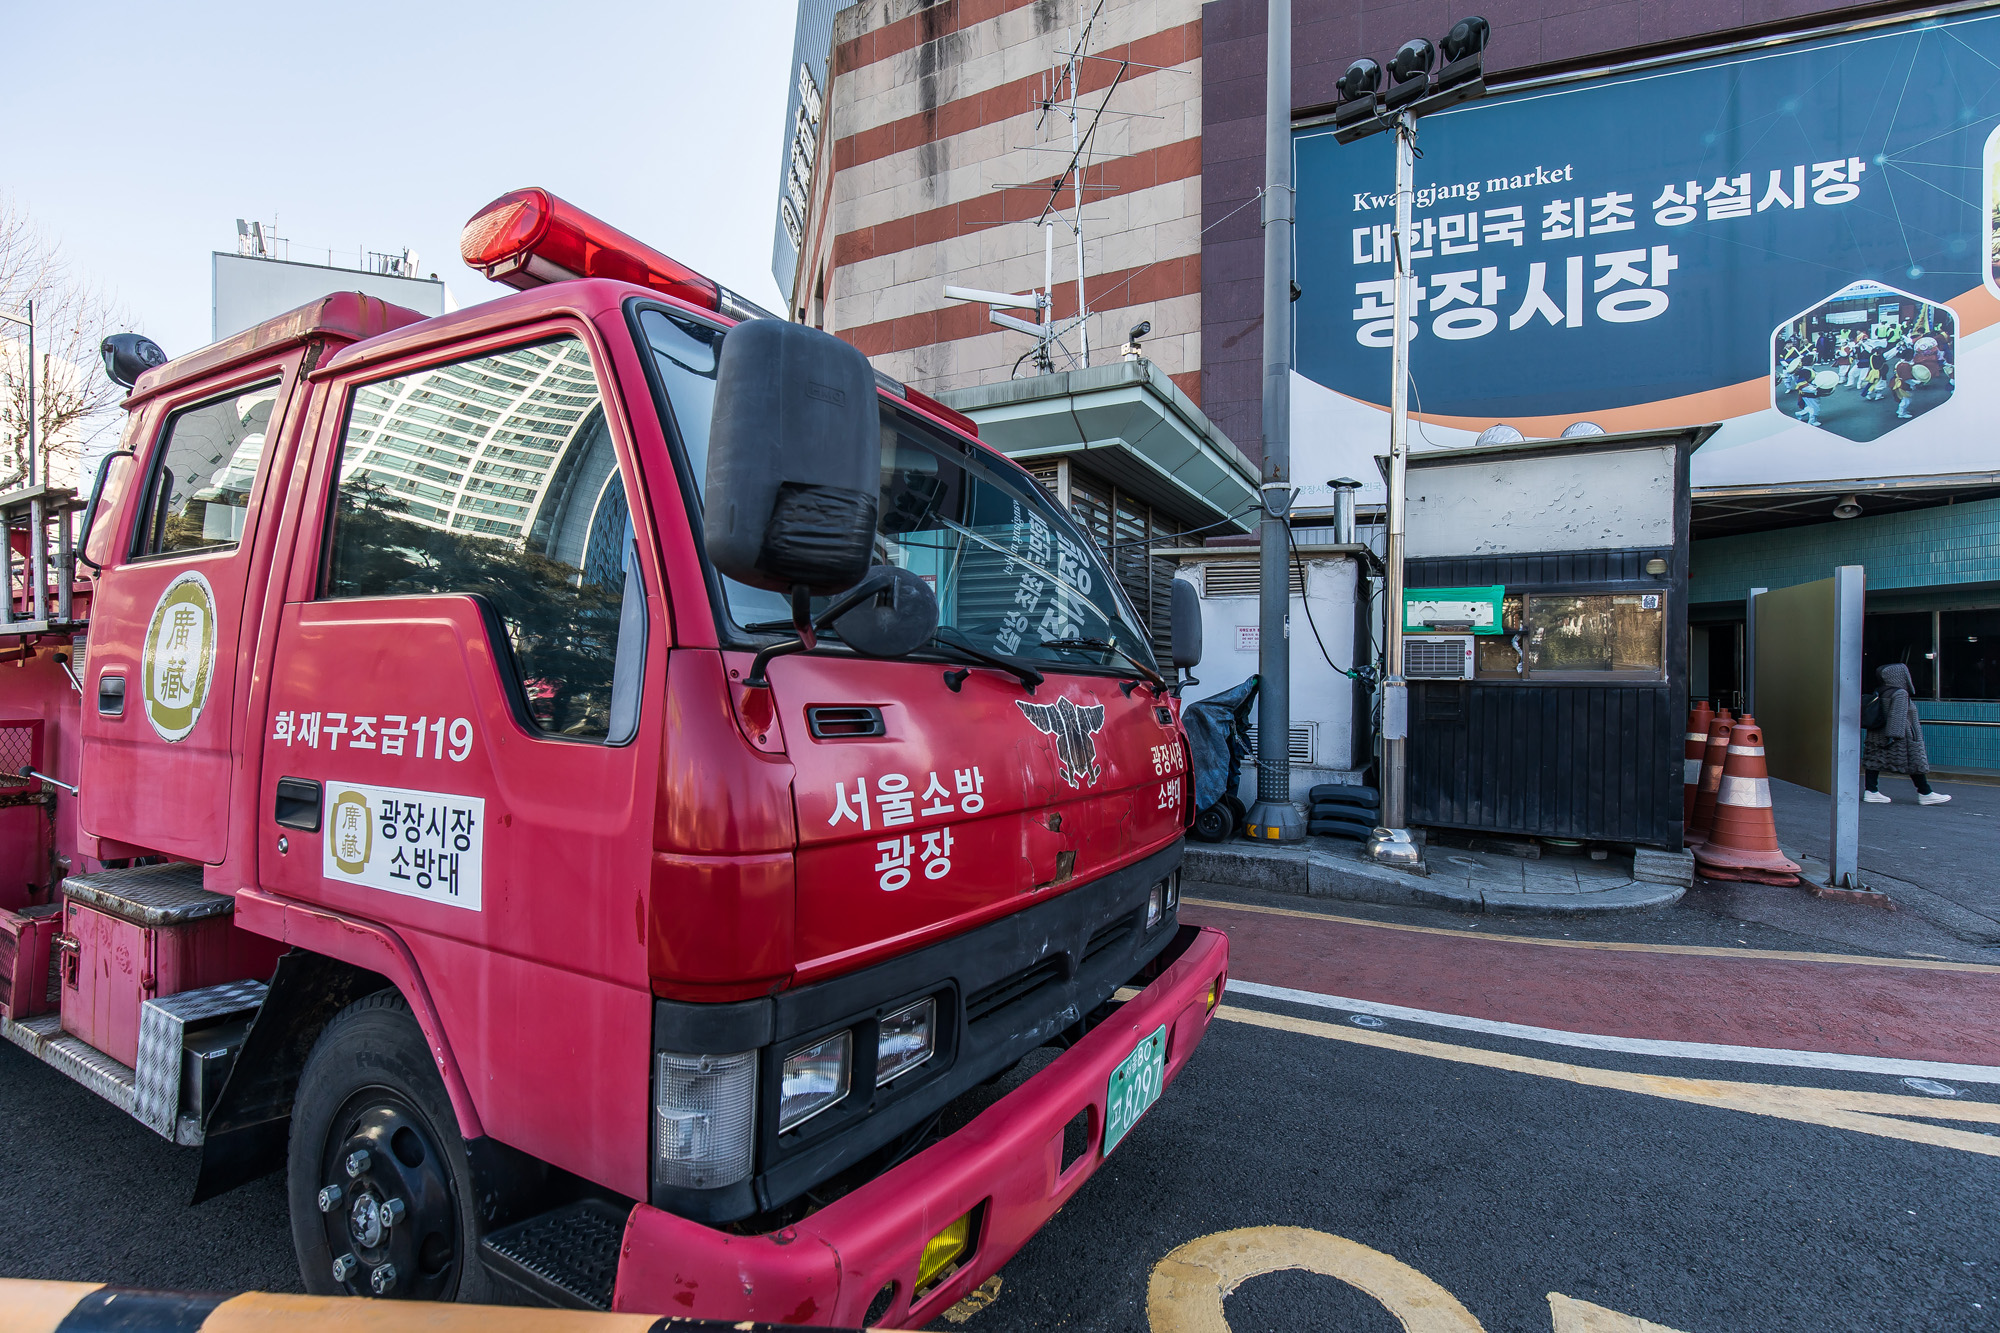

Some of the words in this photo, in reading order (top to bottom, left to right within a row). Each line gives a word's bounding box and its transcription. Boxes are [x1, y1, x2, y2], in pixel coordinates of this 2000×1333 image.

[1352, 181, 1481, 212] Kwagjang
[1487, 163, 1574, 193] market
[1541, 192, 1637, 241] 최초
[1652, 156, 1867, 228] 상설시장
[1352, 245, 1679, 349] 광장시장
[1150, 743, 1183, 775] 광장시장
[827, 766, 986, 831] 서울소방
[1157, 778, 1180, 809] 소방대
[378, 799, 476, 853] 광장시장
[389, 847, 460, 897] 소방대
[874, 826, 955, 893] 광장
